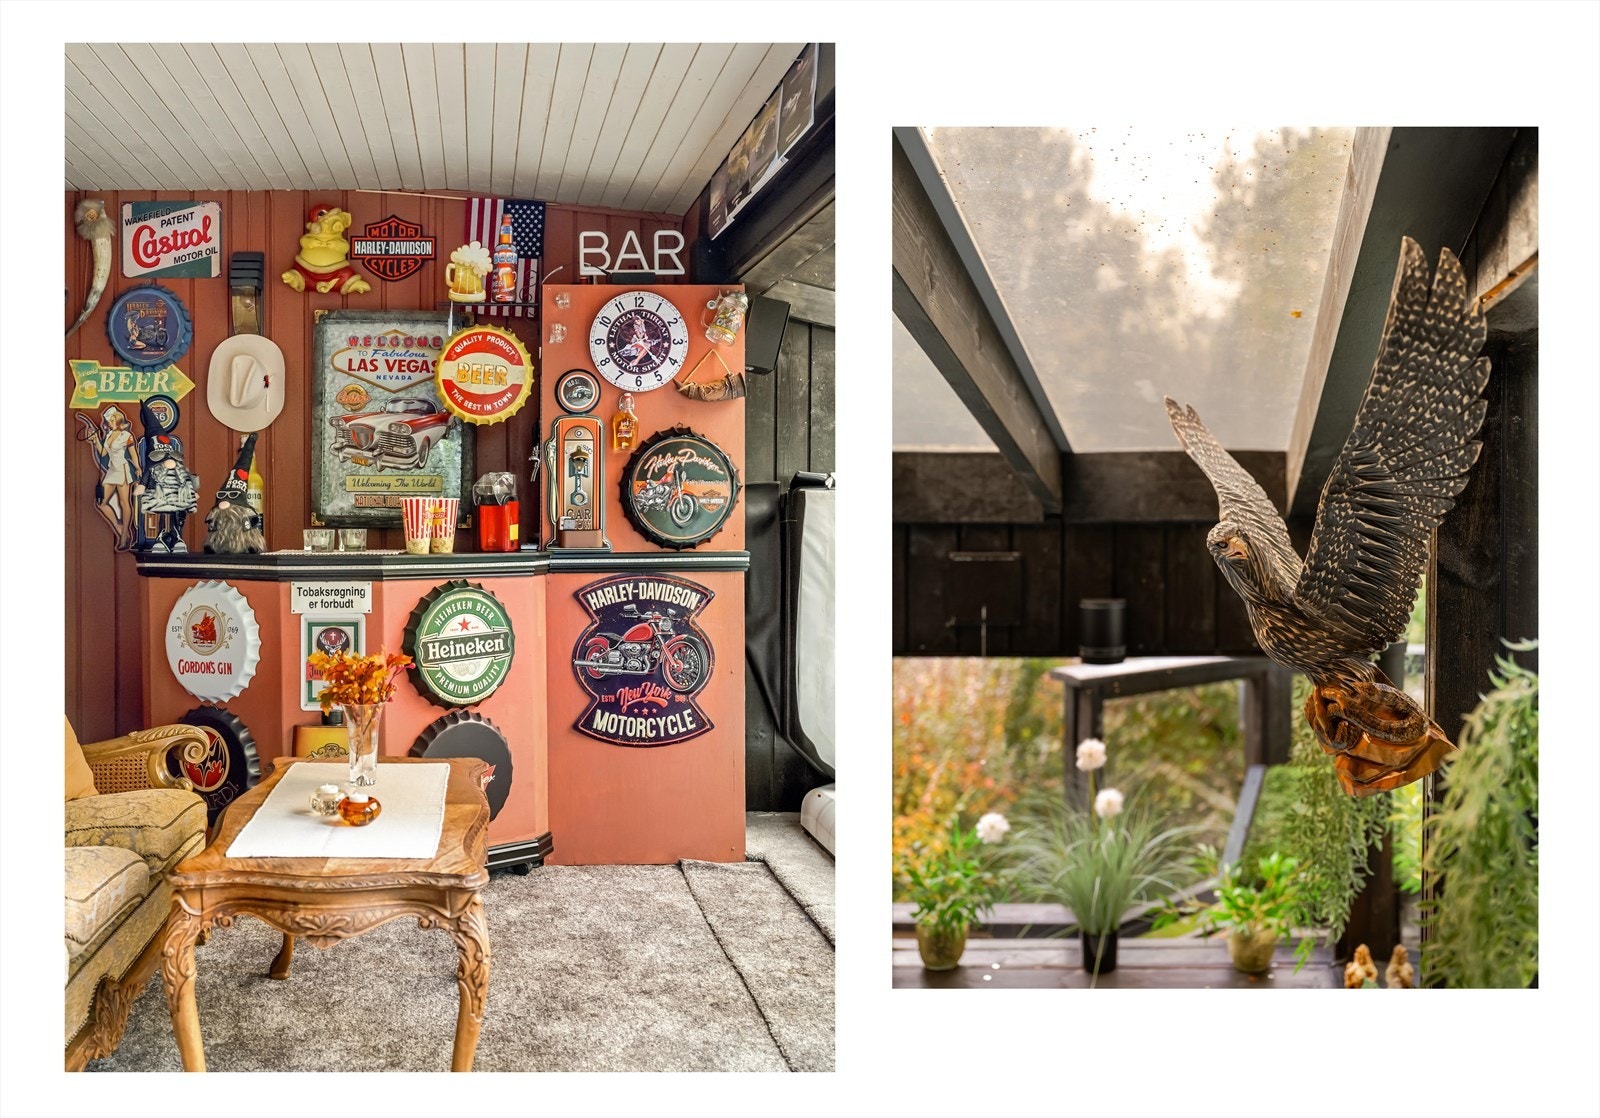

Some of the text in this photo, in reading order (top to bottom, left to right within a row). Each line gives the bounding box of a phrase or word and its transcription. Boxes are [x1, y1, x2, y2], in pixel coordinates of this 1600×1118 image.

[124, 207, 171, 226] WAKEFIELD
[160, 211, 195, 228] PATENT
[371, 221, 416, 237] MOTOR
[132, 215, 212, 268] Castrol
[354, 241, 432, 255] HARLEY-DAVIDSON
[173, 246, 218, 264] MOTOR OIL
[579, 230, 685, 275] BAR
[370, 260, 416, 276] CYCLES
[615, 301, 626, 313] 11
[634, 296, 645, 308] 12
[655, 302, 663, 313] 1
[599, 315, 612, 328] 10
[609, 311, 670, 339] LETHAL THREAT
[667, 317, 679, 327] 2
[348, 335, 443, 349] WELCOME
[454, 335, 516, 356] QUALITY PRODUCT
[672, 338, 684, 346] 3
[371, 349, 429, 358] Fabulous
[668, 356, 679, 366] 4
[348, 358, 437, 374] LAS VEGAS
[599, 357, 611, 367] 8
[611, 351, 639, 373] MOTOR
[97, 371, 170, 393] BEER
[457, 362, 508, 386] BEER
[615, 370, 625, 381] 7
[635, 376, 643, 387] 6
[653, 370, 663, 382] 5
[451, 389, 464, 403] THE
[463, 400, 482, 411] BEST
[493, 391, 513, 409] TOWN
[352, 478, 437, 490] Welcoming The World
[297, 586, 366, 599] Tobaksrøgning
[586, 582, 701, 611] HARLEY-DAVIDSON
[320, 599, 354, 609] forbudt
[434, 600, 495, 627] HEINEKEN BEER
[427, 637, 505, 660] Heineken
[178, 659, 233, 675] GORDON'S GIN
[435, 671, 470, 694] PREMIUM
[472, 664, 500, 692] QUALITY
[616, 687, 642, 713] New
[641, 681, 672, 704] York
[592, 708, 697, 738] MOTORCYCLE
